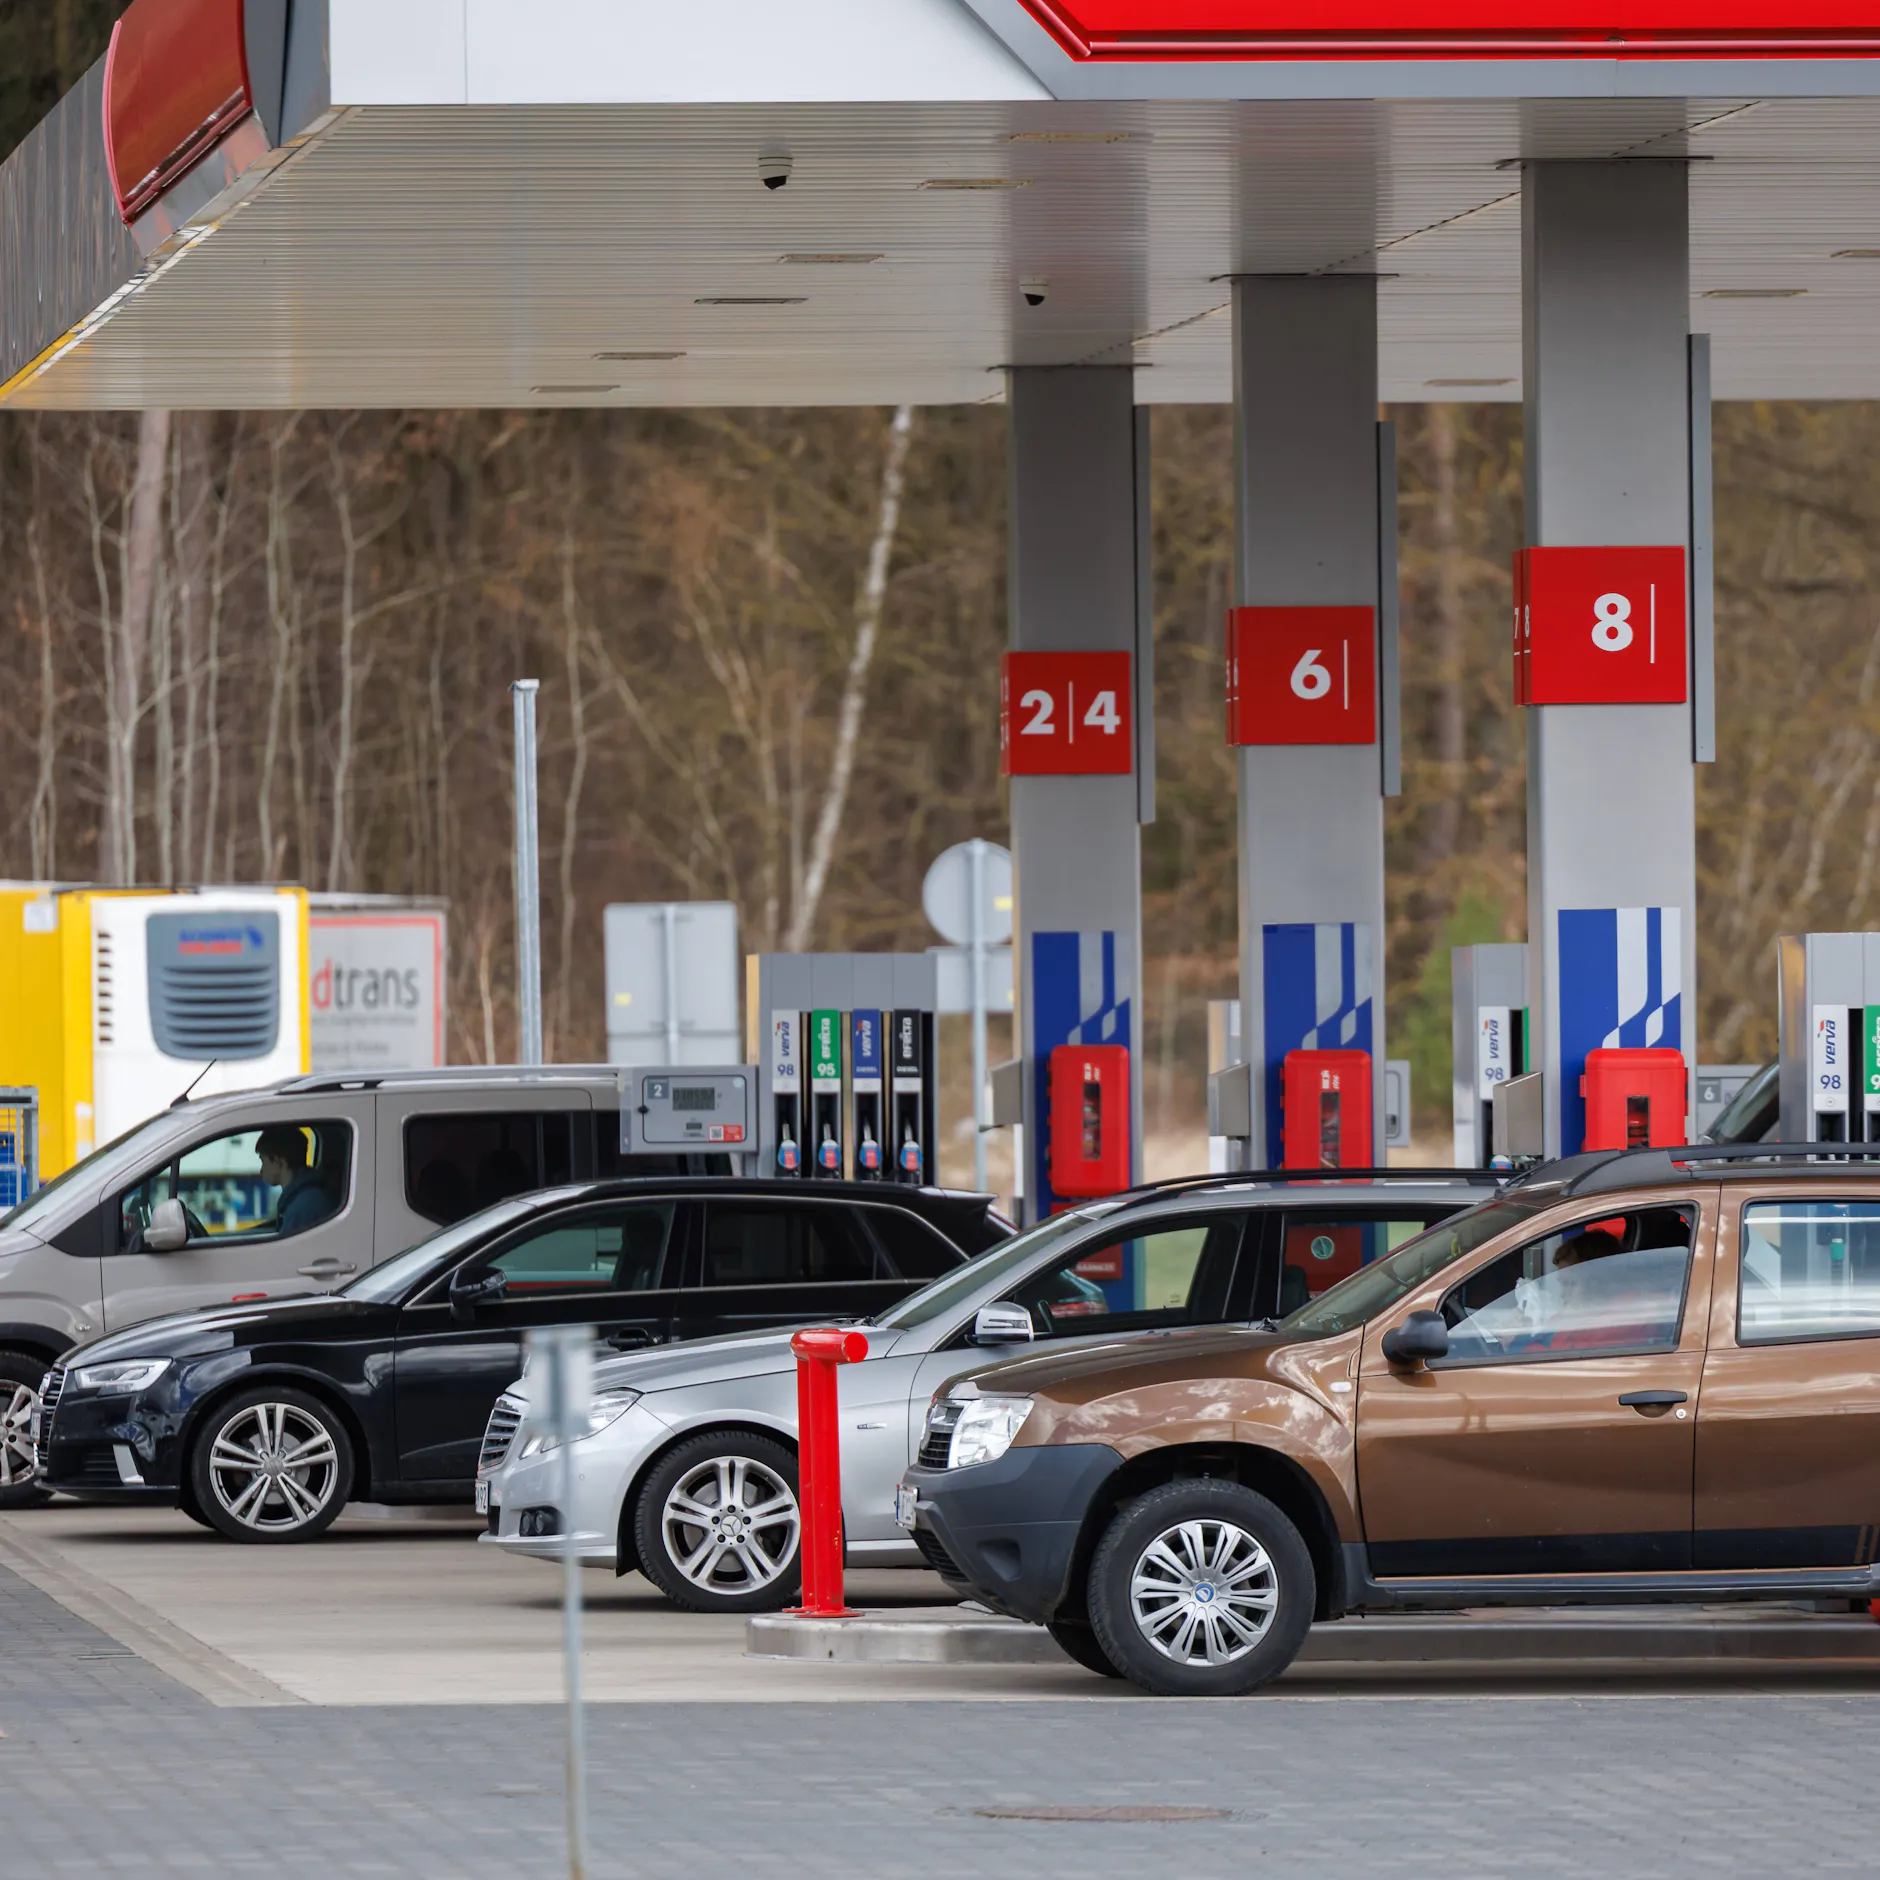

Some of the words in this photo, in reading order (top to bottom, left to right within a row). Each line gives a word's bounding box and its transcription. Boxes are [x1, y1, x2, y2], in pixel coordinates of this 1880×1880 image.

[1591, 592, 1634, 652] 8
[1290, 649, 1331, 700] 6
[1020, 689, 1055, 734] 2
[1083, 690, 1121, 734] 4
[311, 956, 420, 1011] dtrans
[781, 1020, 790, 1057] verva
[862, 1019, 872, 1057] verva
[1489, 1019, 1499, 1059] verva
[1825, 1019, 1836, 1065] verva
[777, 1063, 794, 1076] 98
[817, 1062, 836, 1077] 95
[1484, 1067, 1504, 1080] 98
[1820, 1074, 1841, 1090] 98
[1870, 1073, 1880, 1090] 9
[654, 1084, 663, 1097] 2
[1703, 1086, 1715, 1101] 6
